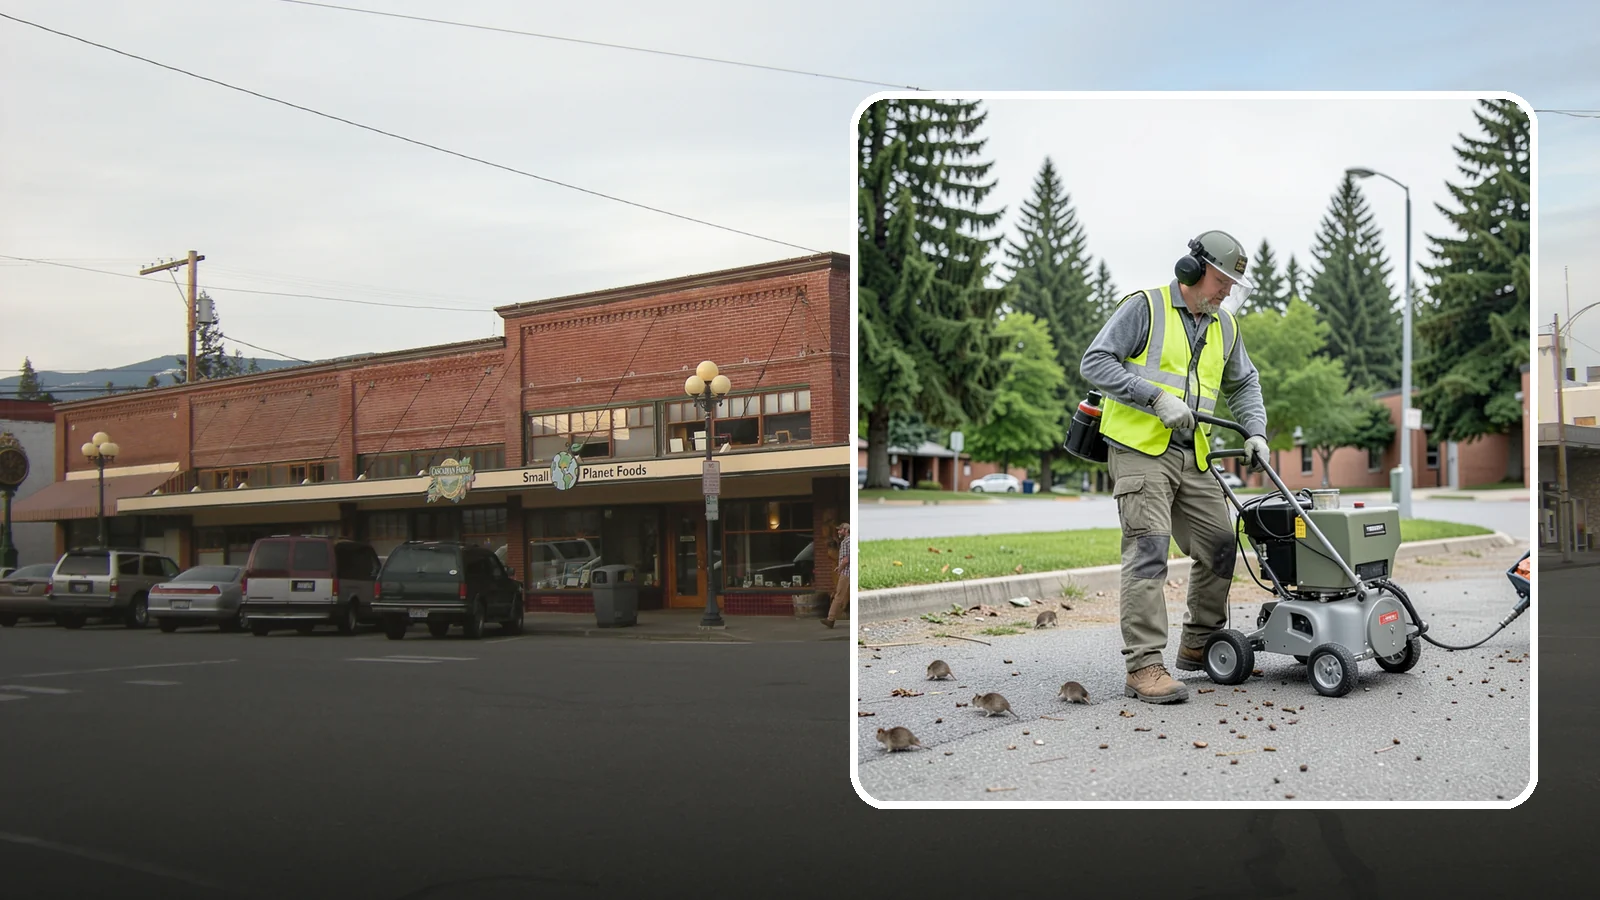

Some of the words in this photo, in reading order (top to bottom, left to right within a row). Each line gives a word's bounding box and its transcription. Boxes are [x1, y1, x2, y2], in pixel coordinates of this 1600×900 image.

[523, 471, 549, 482] Small
[583, 467, 614, 479] Planet
[617, 464, 647, 477] Foods
